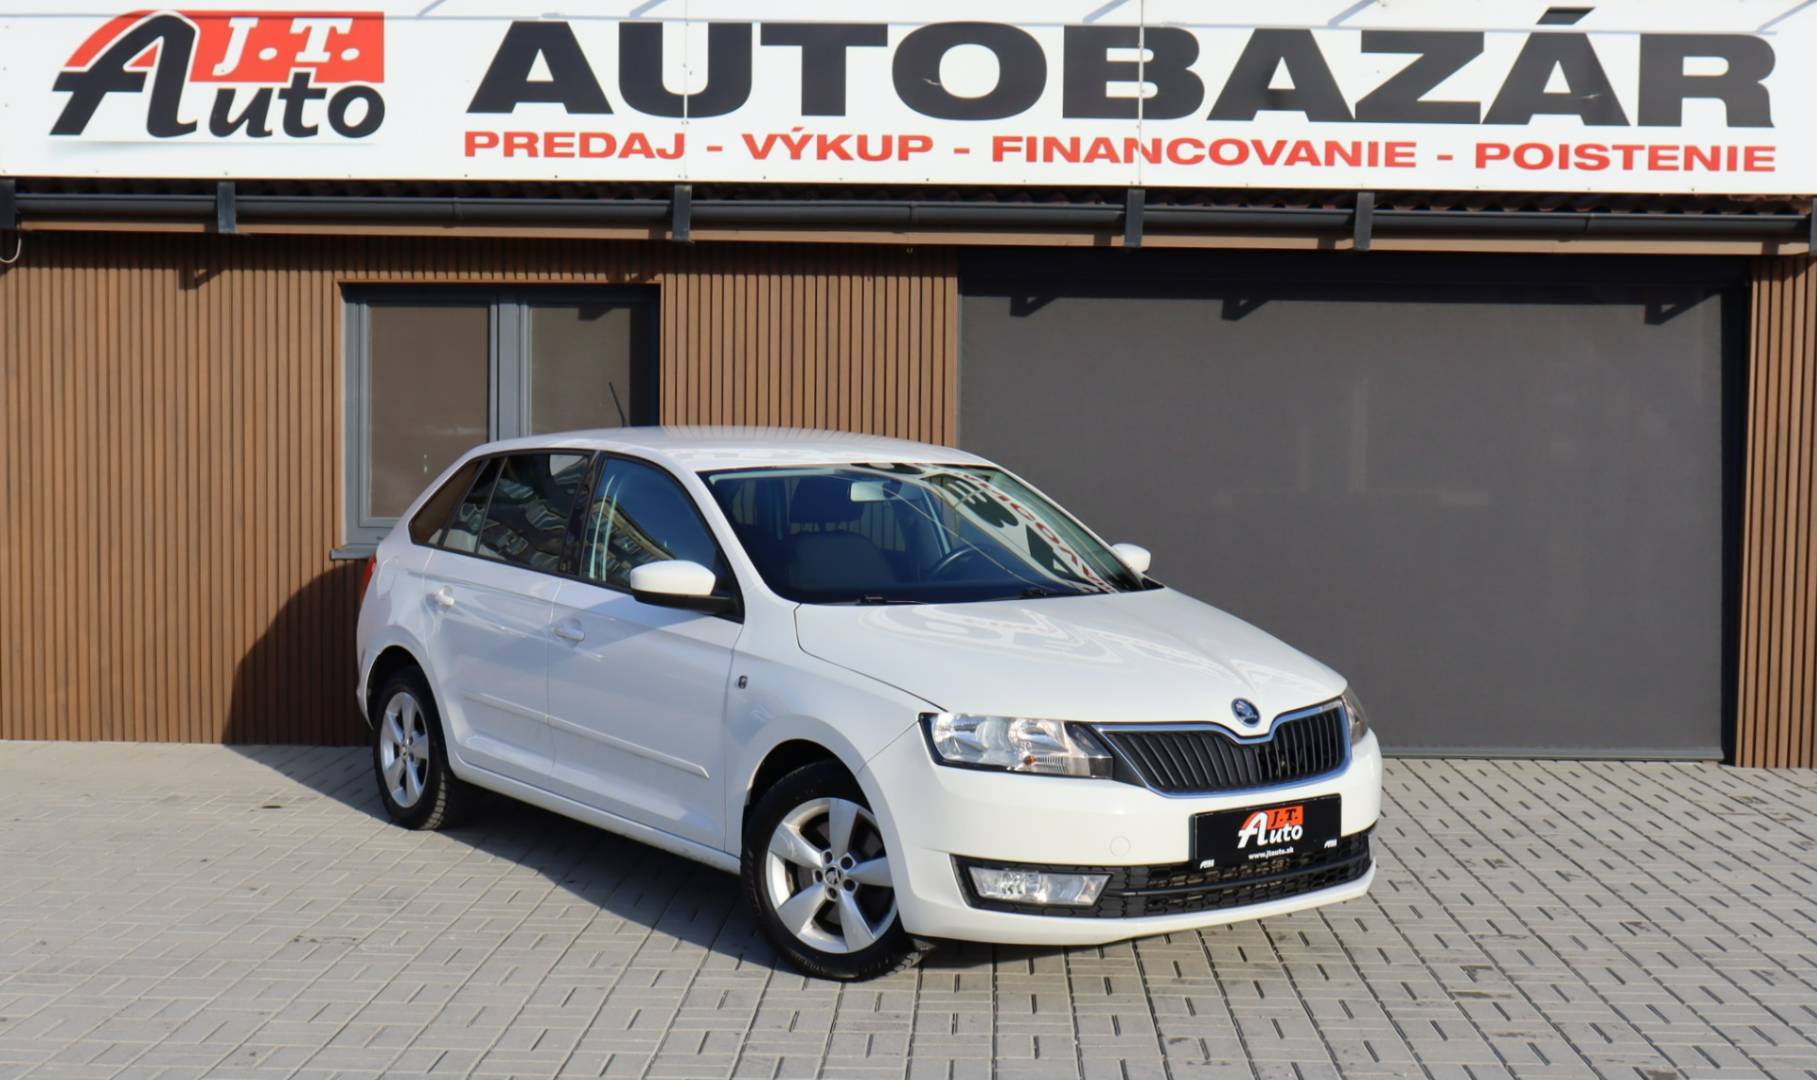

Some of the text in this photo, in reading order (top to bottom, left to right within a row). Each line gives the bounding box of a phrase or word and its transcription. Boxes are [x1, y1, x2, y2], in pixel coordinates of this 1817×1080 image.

[49, 13, 386, 139] Auto
[212, 16, 361, 77] J.T.
[466, 7, 1775, 128] AUTOBAZÁR
[464, 130, 686, 160] PREDAJ
[742, 126, 934, 162] VÝKUP
[992, 135, 1417, 169] FINANCOVANIE
[1475, 142, 1776, 172] POISTENIE
[1237, 811, 1303, 849] Auto
